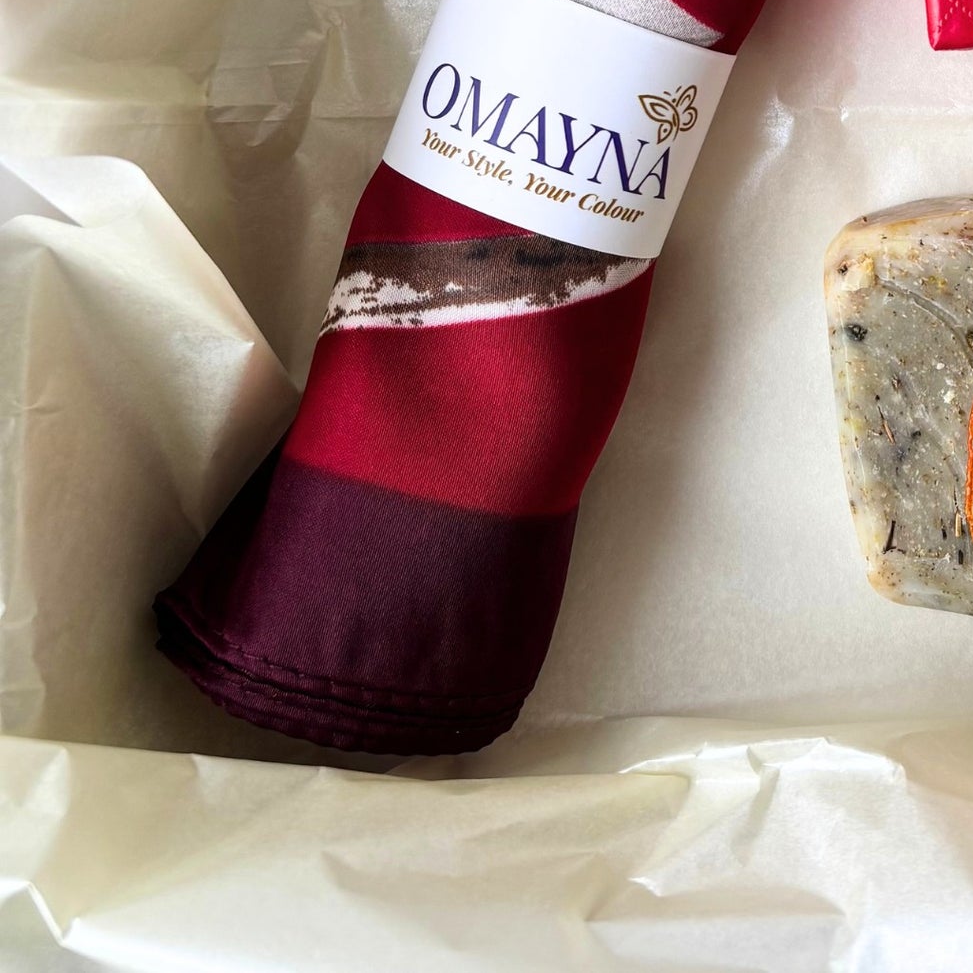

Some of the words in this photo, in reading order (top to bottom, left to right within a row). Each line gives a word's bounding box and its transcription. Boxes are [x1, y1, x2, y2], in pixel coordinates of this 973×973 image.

[421, 128, 462, 158] Your
[461, 149, 514, 185] Style,
[523, 172, 576, 204] Your
[578, 193, 645, 223] Colour
[422, 63, 671, 200] OMAYNA
